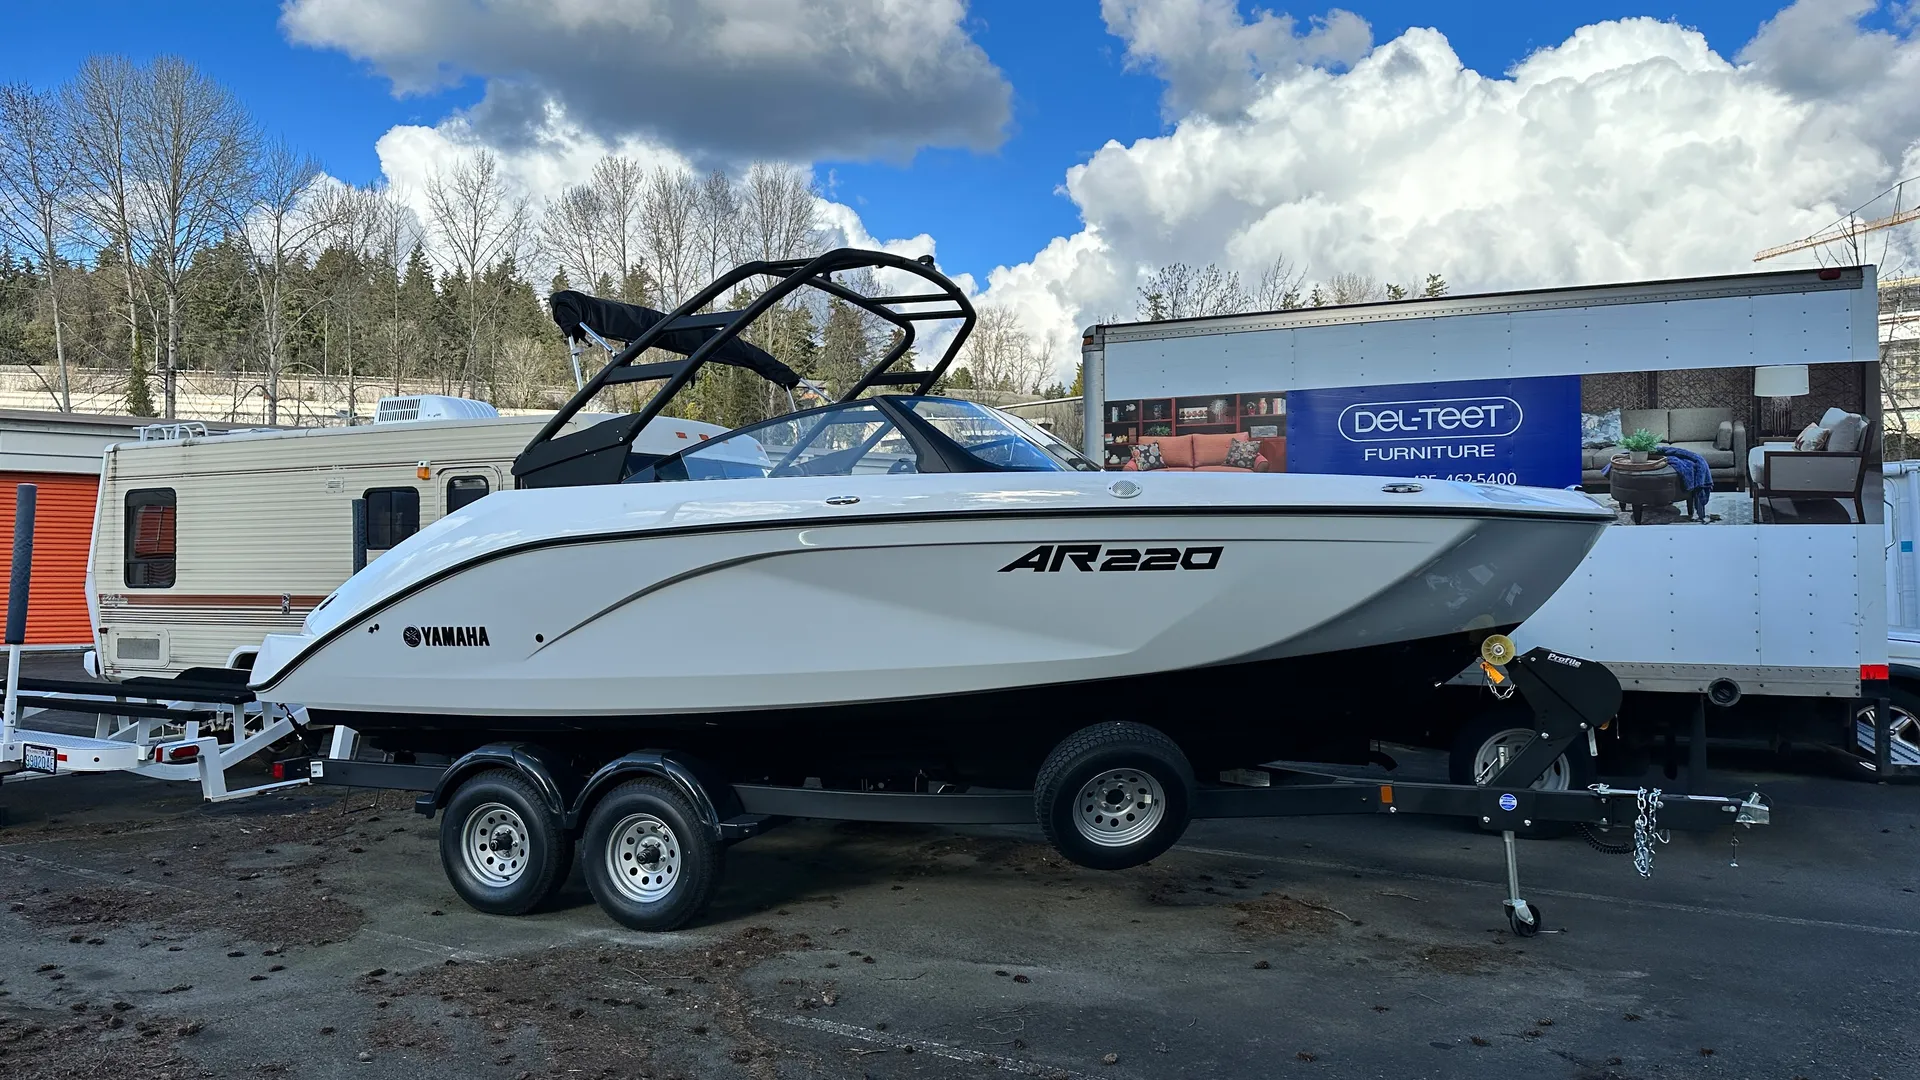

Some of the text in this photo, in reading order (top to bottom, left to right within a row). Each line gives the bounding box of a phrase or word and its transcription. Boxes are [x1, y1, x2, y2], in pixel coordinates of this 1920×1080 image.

[1364, 444, 1496, 461] FURNITURE
[997, 544, 1224, 573] AR220
[420, 626, 490, 647] YAMAHA
[1547, 652, 1582, 667] Profile
